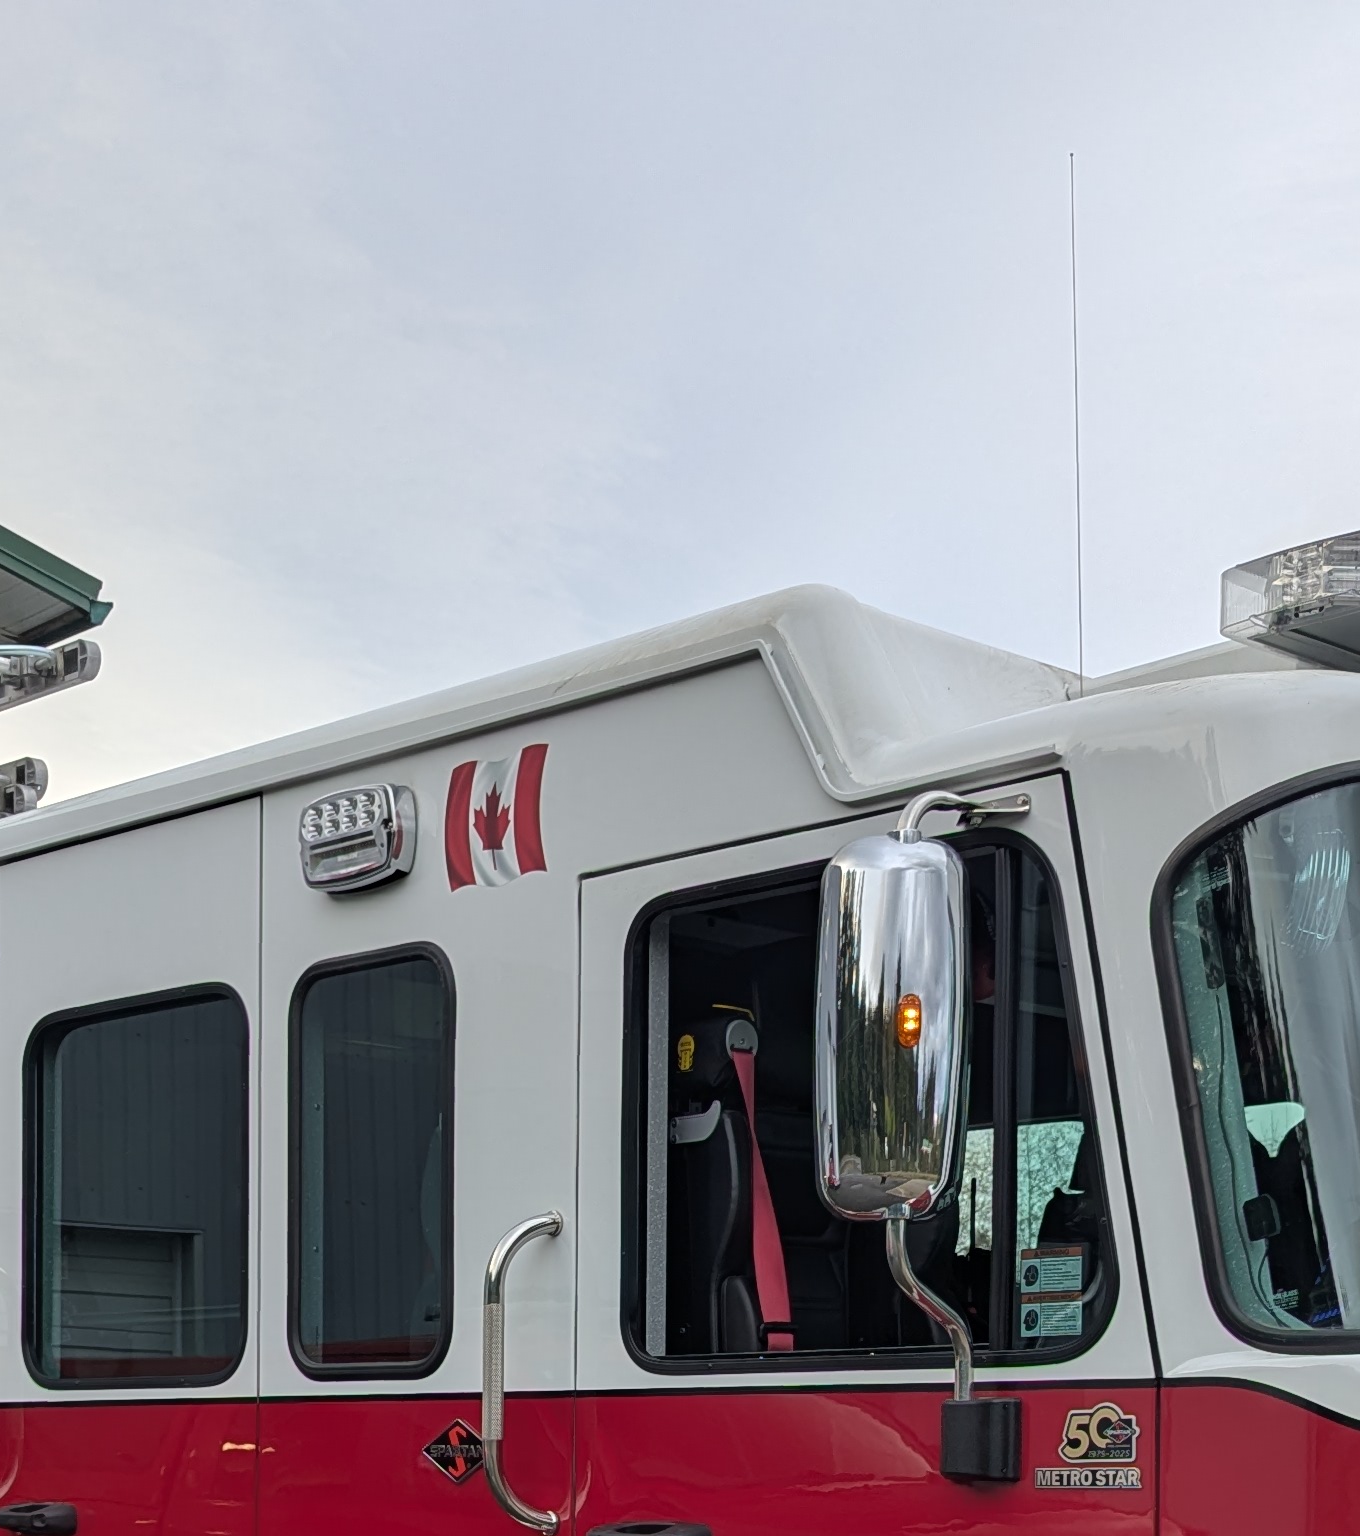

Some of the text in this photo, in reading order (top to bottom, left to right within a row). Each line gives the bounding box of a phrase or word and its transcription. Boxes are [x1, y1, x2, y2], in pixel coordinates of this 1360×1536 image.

[429, 1444, 483, 1458] SPARTAN
[1036, 1470, 1138, 1486] METRO STAR
